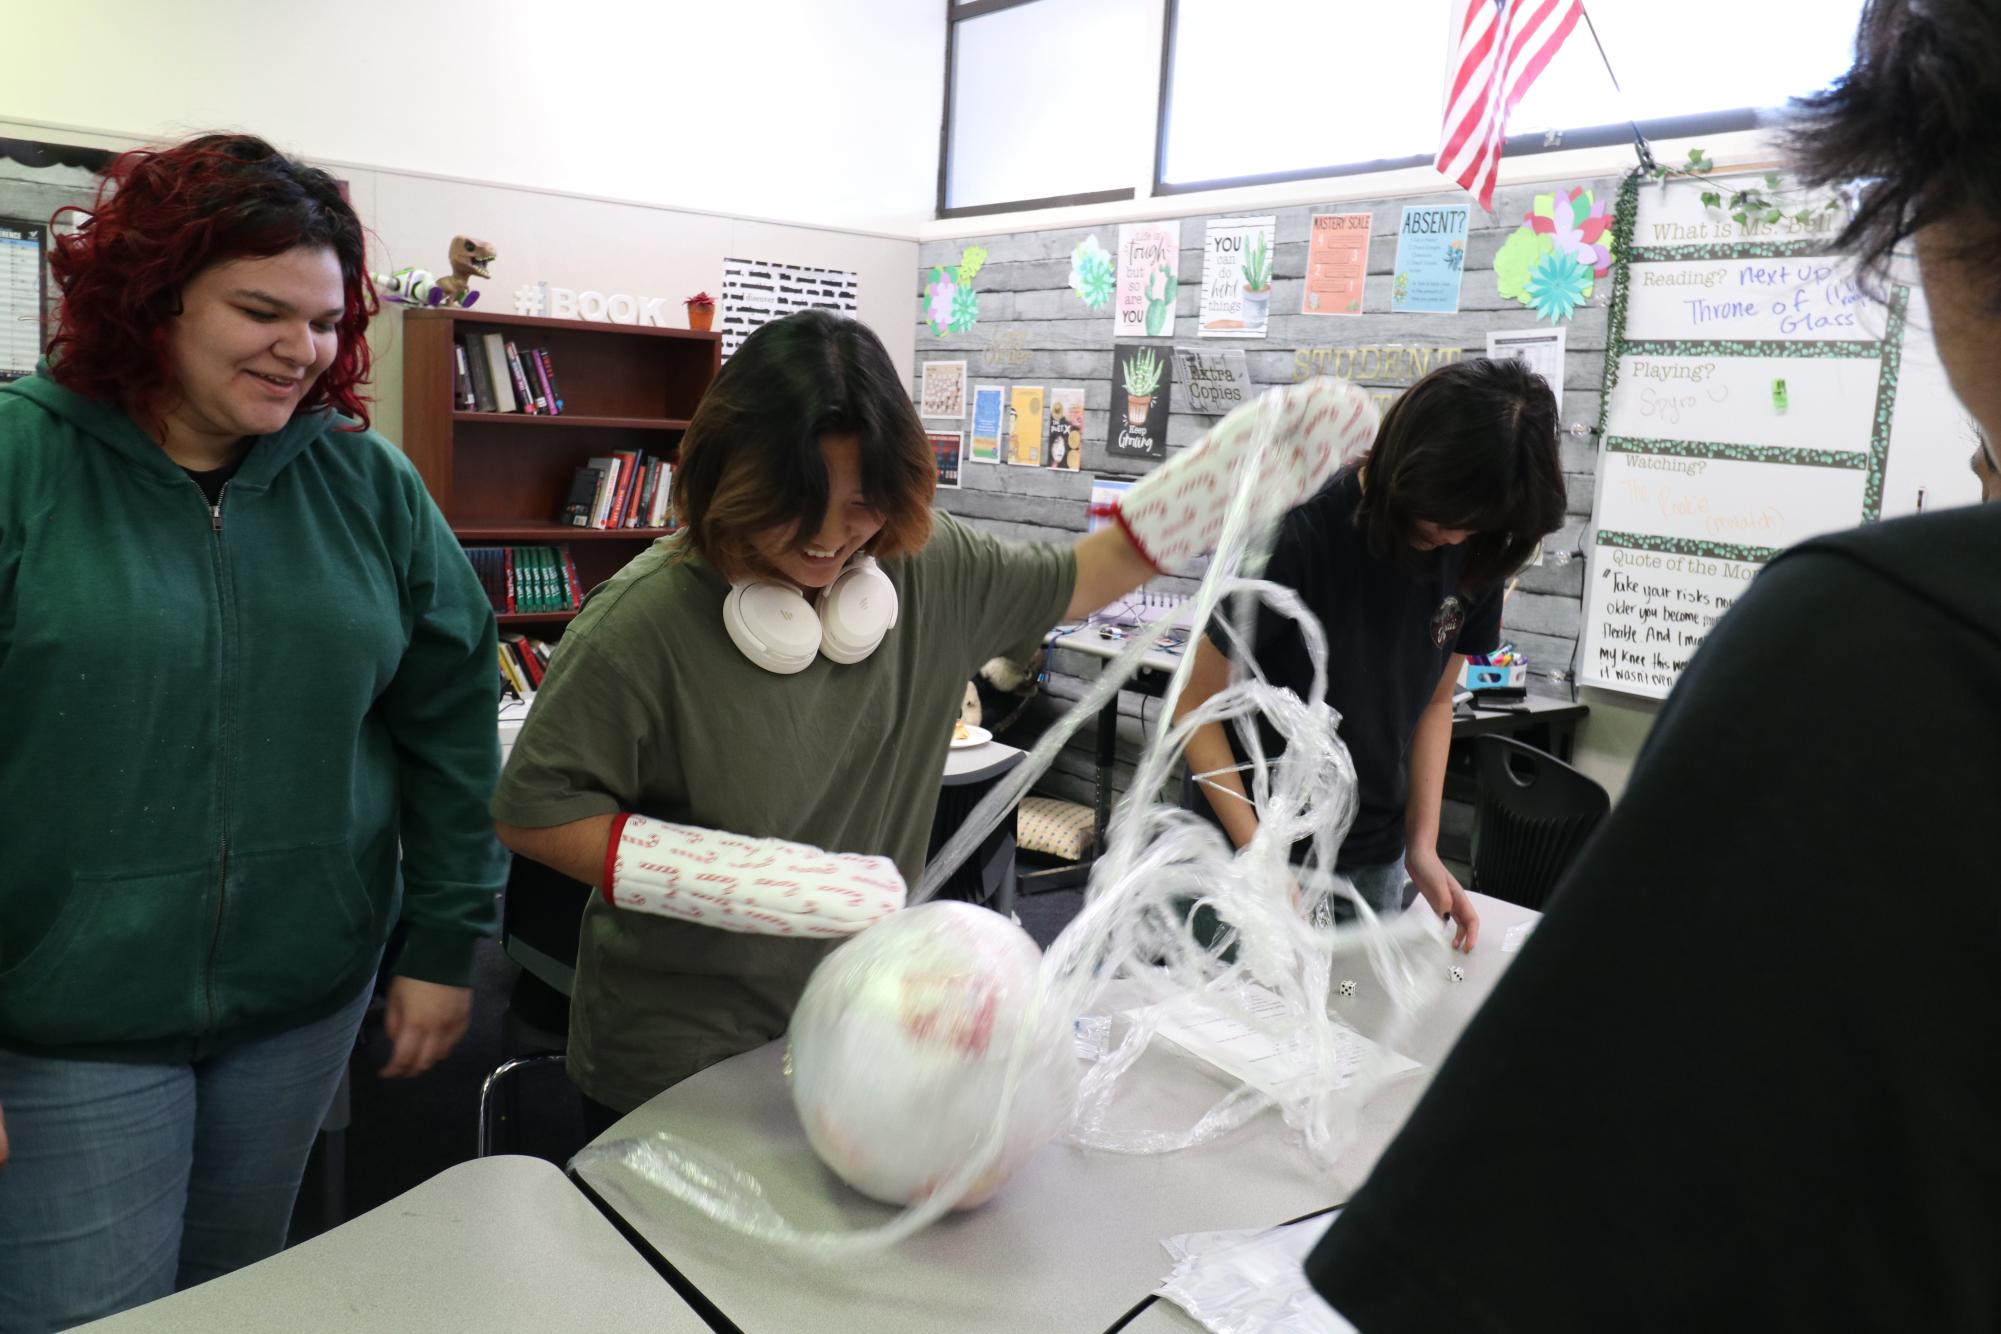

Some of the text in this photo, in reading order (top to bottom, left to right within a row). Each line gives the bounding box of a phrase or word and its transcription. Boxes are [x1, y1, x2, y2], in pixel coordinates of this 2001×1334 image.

[1403, 211, 1466, 234] ABSENT?
[1653, 223, 1708, 241] What
[1713, 221, 1732, 238] is
[1214, 236, 1241, 252] YOU
[1217, 255, 1236, 265] can
[1126, 266, 1144, 278] but
[1218, 267, 1232, 278] do
[1643, 268, 1727, 288] Reading?
[1128, 282, 1140, 291] so
[1124, 295, 1142, 305] are
[1208, 300, 1242, 314] things
[1683, 298, 1758, 324] Throne
[1772, 289, 1808, 315] of
[1123, 310, 1144, 323] YOU
[1780, 312, 1854, 334] Glass
[1189, 365, 1235, 382] Extra
[1632, 362, 1716, 382] Playing?
[1189, 383, 1241, 402] Copies
[1129, 425, 1147, 436] Keep
[1626, 454, 1707, 476] Watching?
[1612, 549, 1661, 568] Quote
[1666, 556, 1686, 571] of
[1688, 559, 1717, 576] the
[1676, 589, 1710, 605] risks
[1639, 606, 1657, 624] you
[1663, 605, 1699, 624] become
[1646, 626, 1671, 643] And
[1654, 652, 1670, 670] this
[1652, 673, 1673, 687] even
